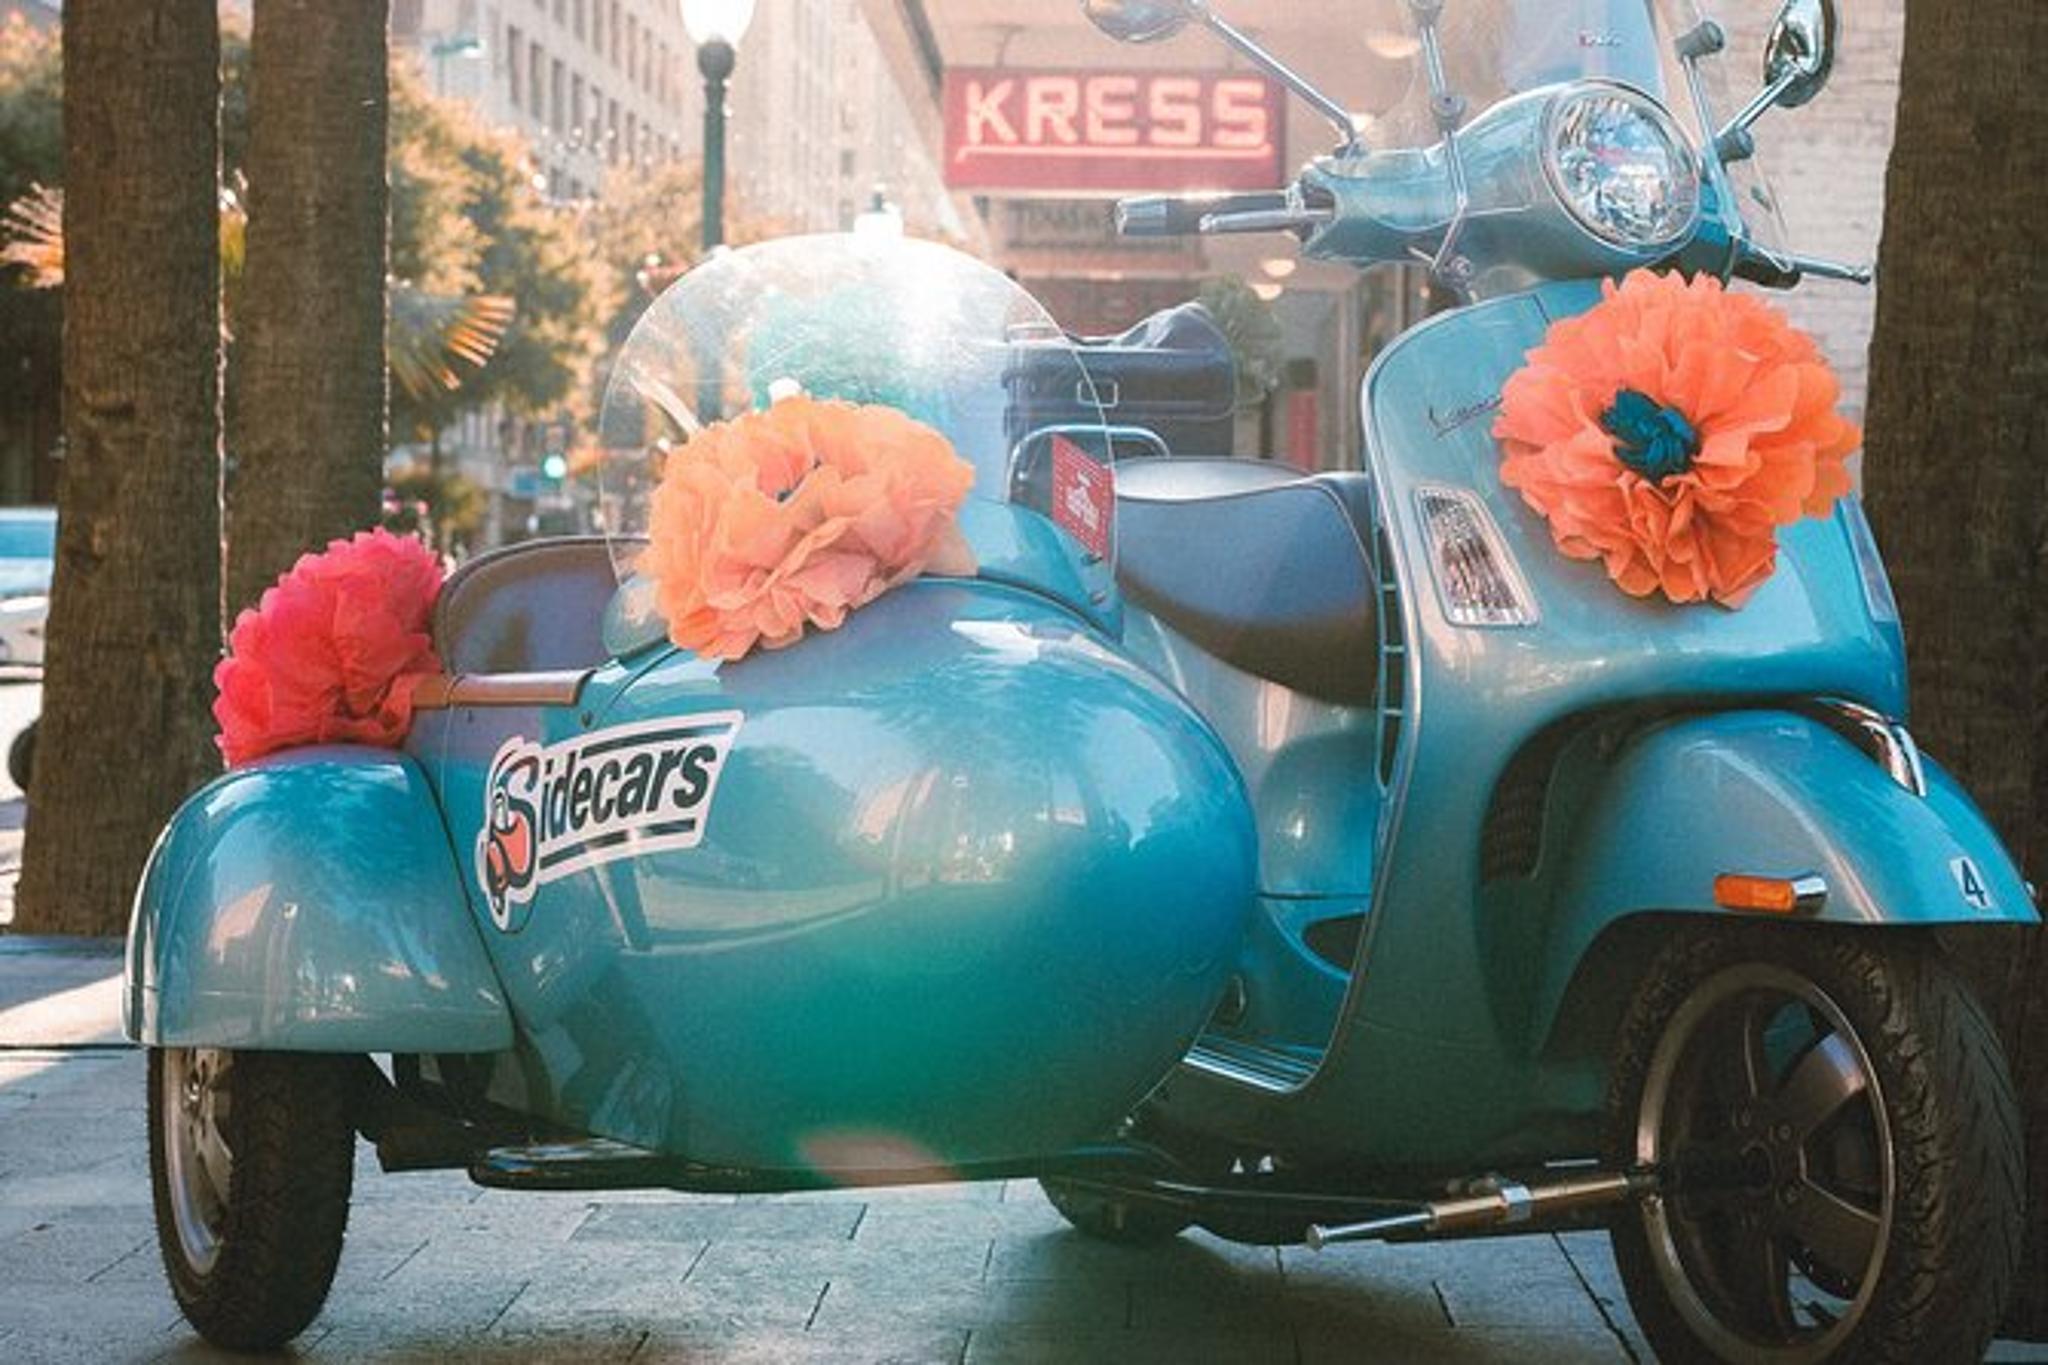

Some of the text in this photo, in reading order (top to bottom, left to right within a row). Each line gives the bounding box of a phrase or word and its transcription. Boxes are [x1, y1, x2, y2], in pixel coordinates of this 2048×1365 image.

[965, 76, 1269, 147] KRESS
[486, 744, 717, 902] Sidecars
[1961, 859, 1987, 906] 4
